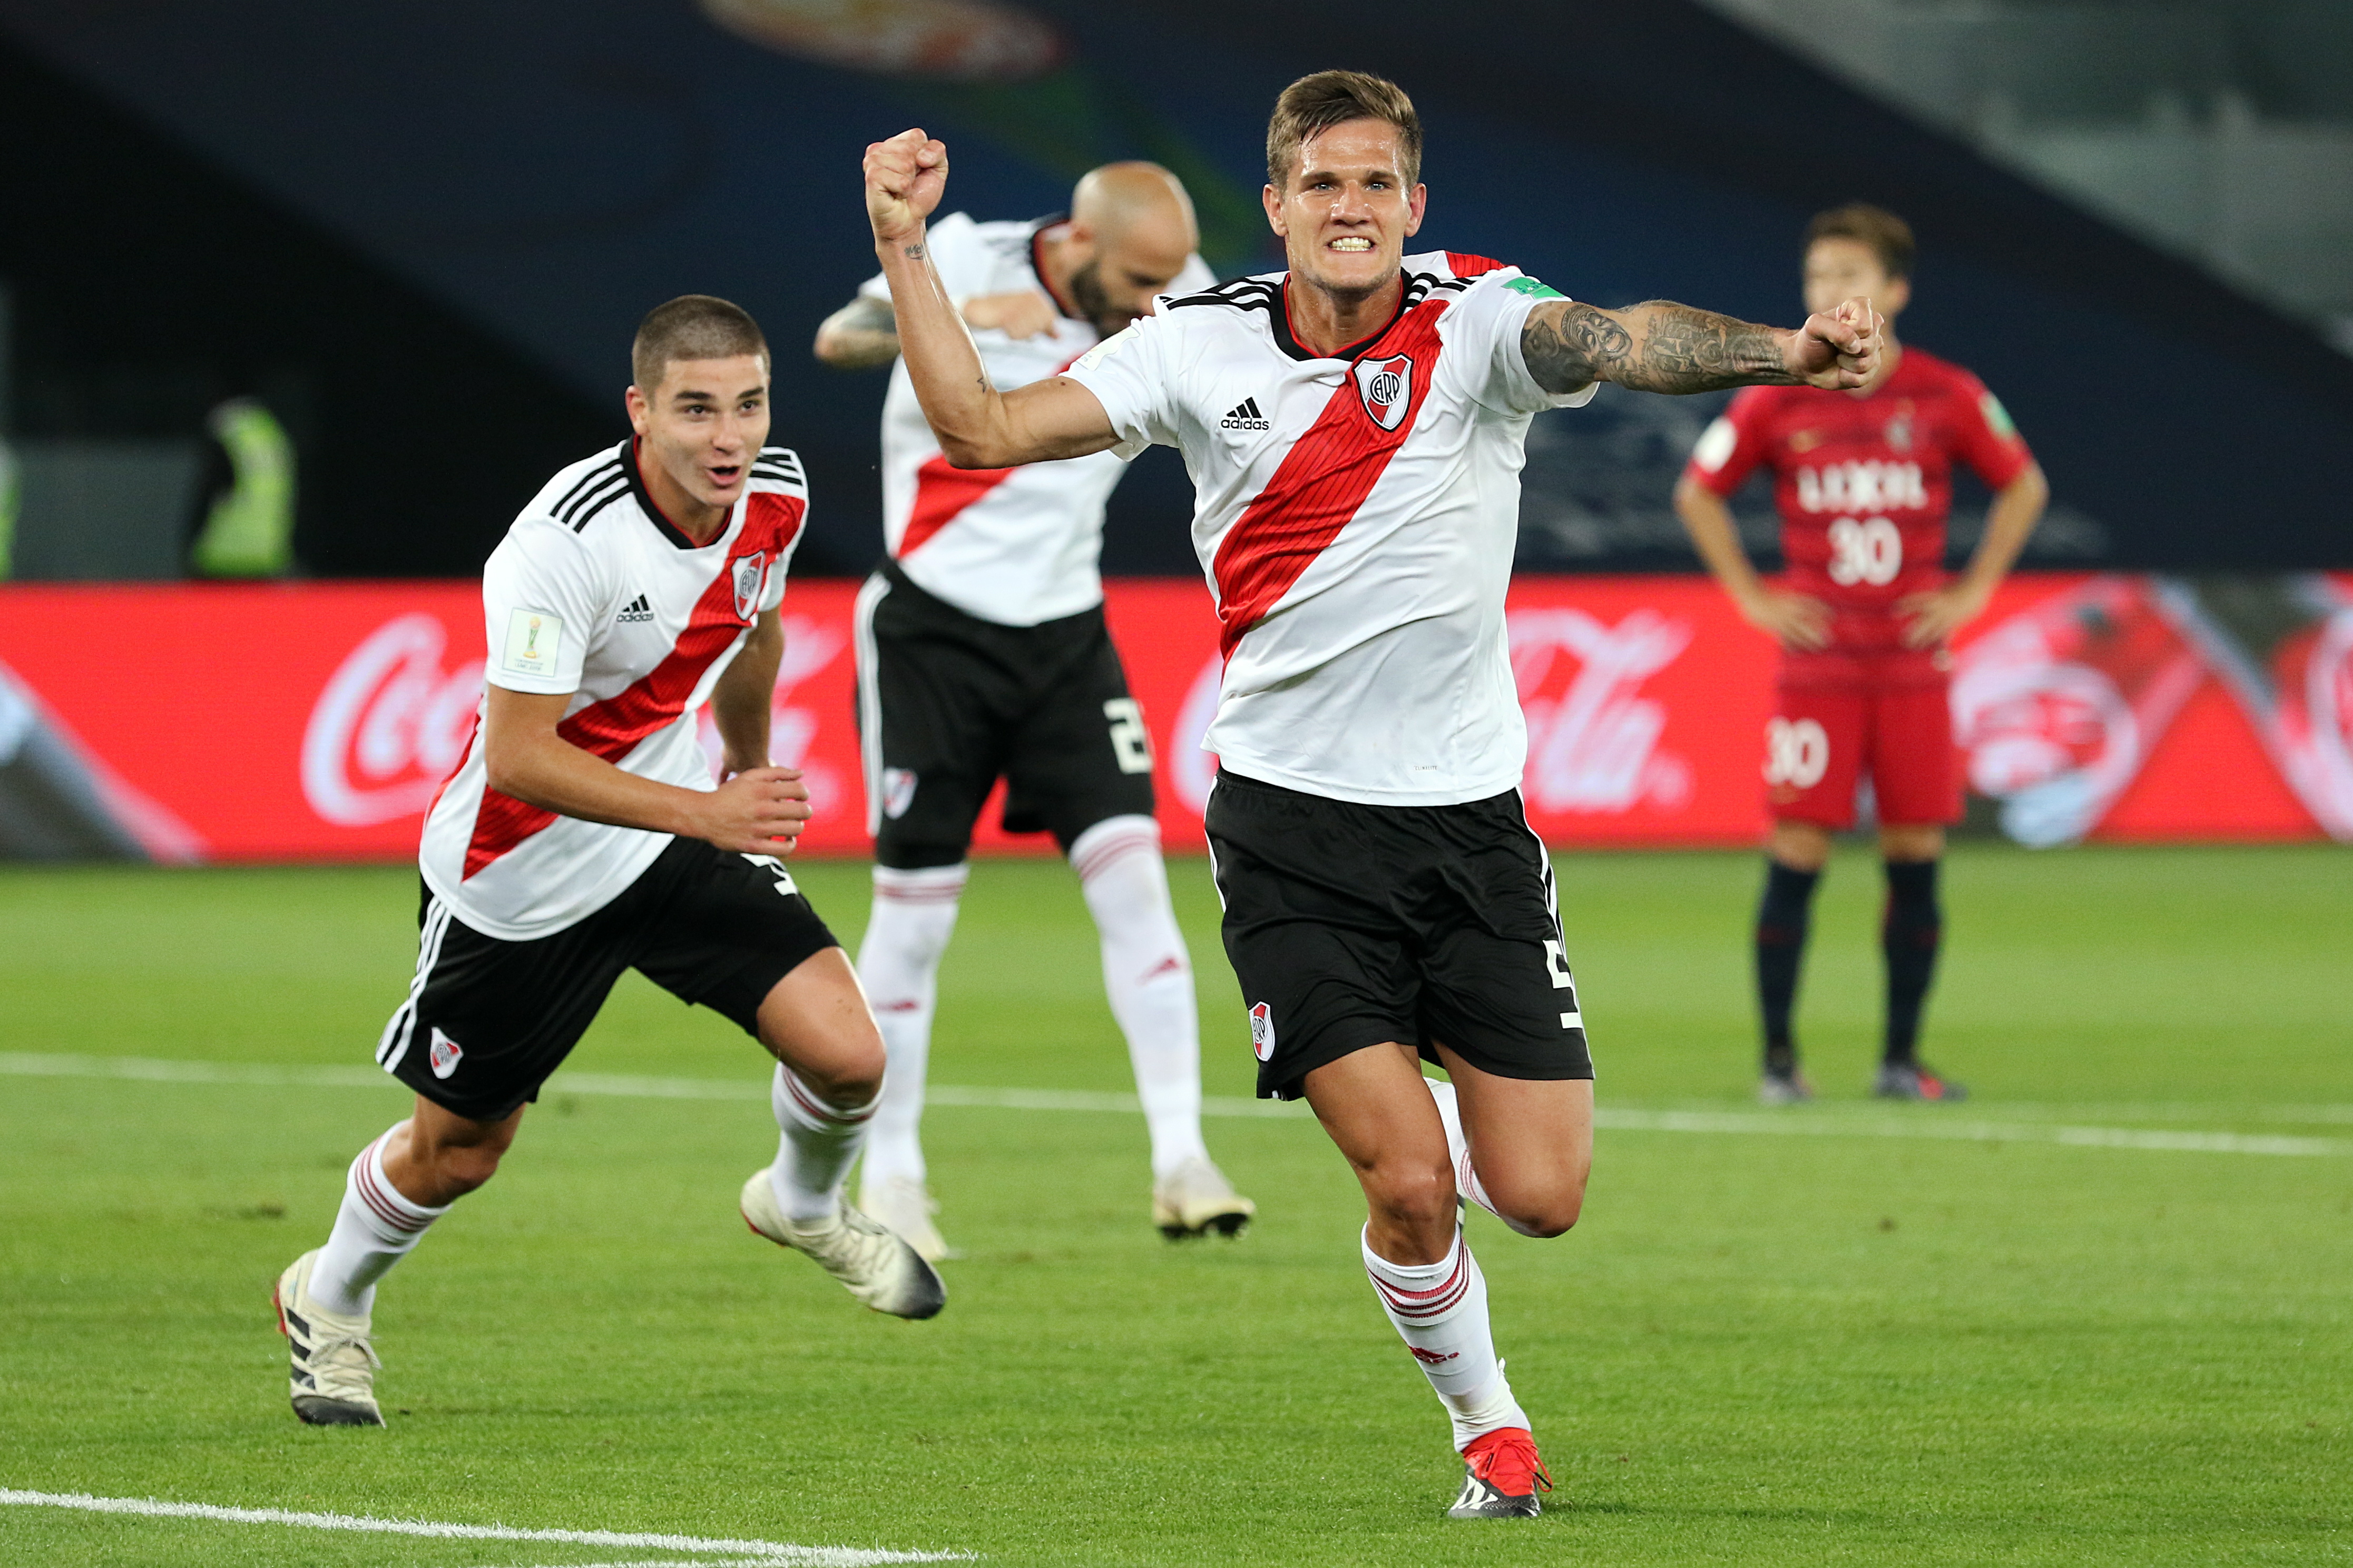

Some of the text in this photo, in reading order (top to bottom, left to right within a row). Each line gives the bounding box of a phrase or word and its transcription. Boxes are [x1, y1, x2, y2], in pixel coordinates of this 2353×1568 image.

[1370, 373, 1400, 404] CARP
[1221, 417, 1270, 430] adidas
[1827, 516, 1903, 586] 30
[616, 611, 654, 622] adidas
[1762, 716, 1829, 788] 30
